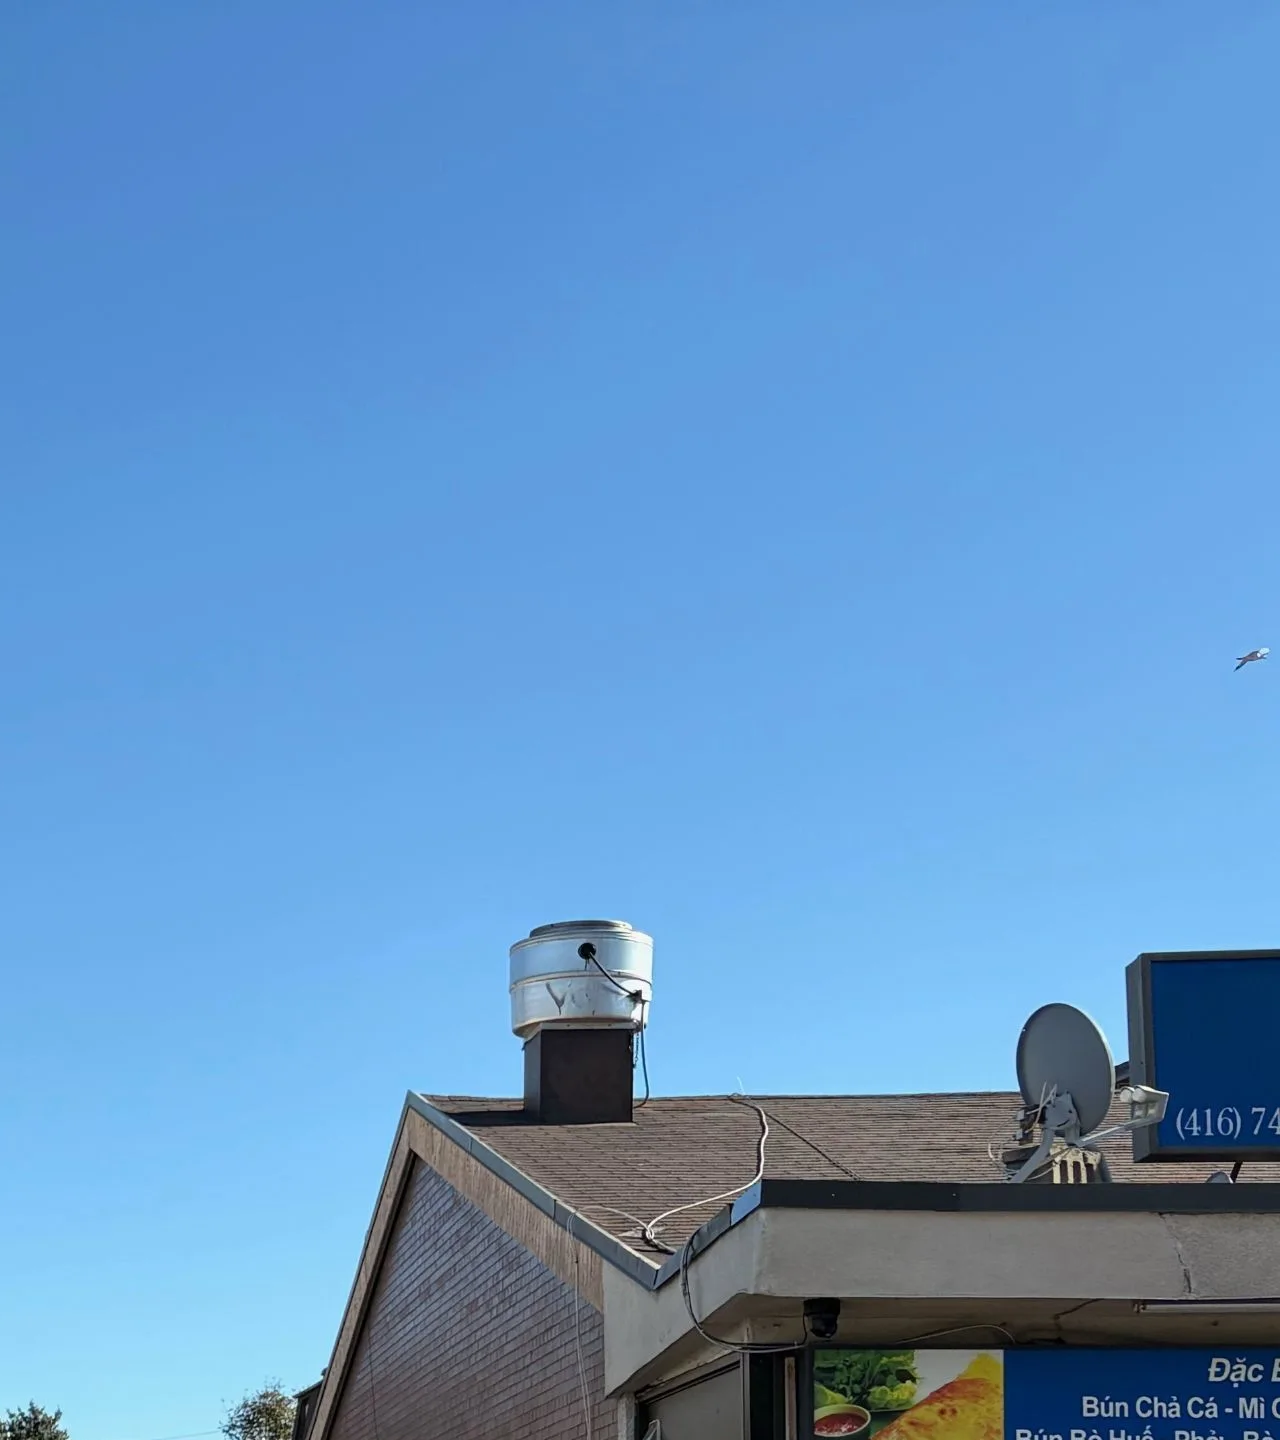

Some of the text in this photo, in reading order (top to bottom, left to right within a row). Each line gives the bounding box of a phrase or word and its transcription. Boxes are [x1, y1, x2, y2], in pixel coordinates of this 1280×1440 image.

[1176, 1106, 1242, 1140] (416)
[1208, 1356, 1264, 1388] Đặc
[1082, 1395, 1129, 1418] Bún
[1136, 1395, 1181, 1418] Chả
[1187, 1396, 1218, 1419] Cá
[1239, 1397, 1265, 1419] Mì
